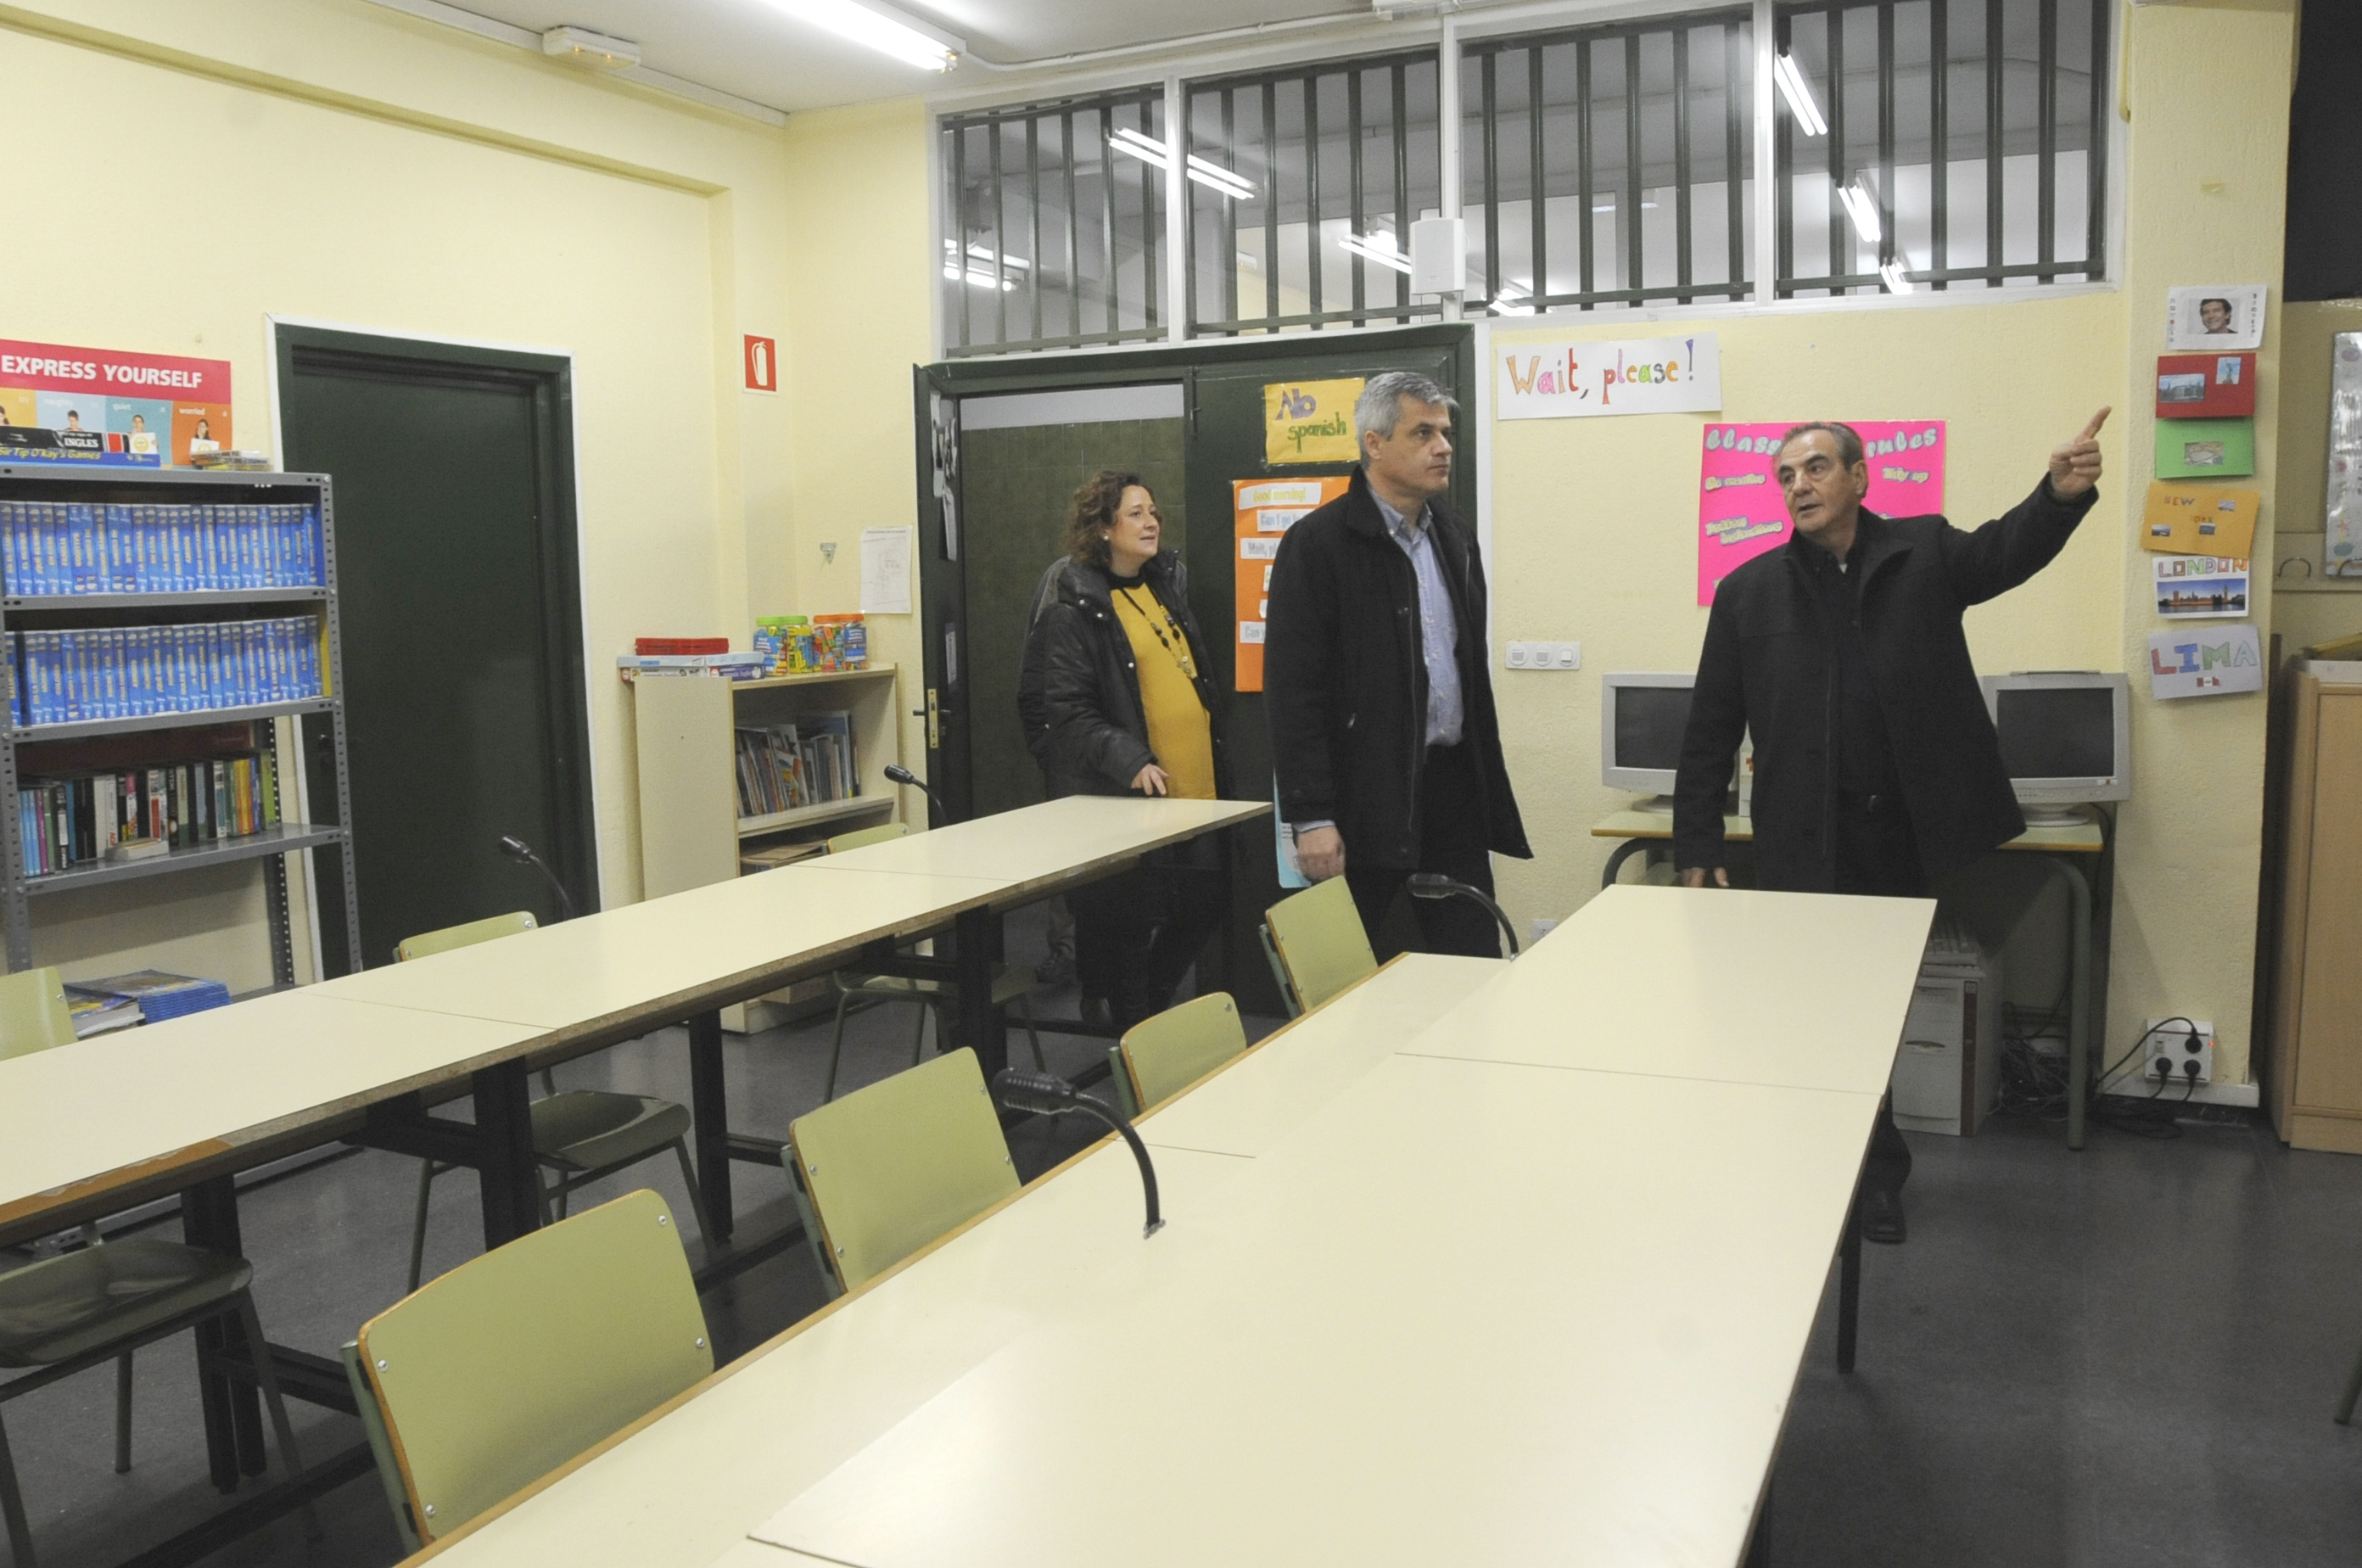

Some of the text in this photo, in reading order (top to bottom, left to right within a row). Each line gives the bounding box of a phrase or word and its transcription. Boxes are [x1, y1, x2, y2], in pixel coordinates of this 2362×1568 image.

[1, 355, 203, 389] EXPRESS YOURSELF
[1506, 347, 1589, 400] Wait,
[179, 407, 205, 416] worried
[1274, 388, 1317, 420] No
[1287, 412, 1347, 453] spanish
[1705, 428, 1939, 459] Class rules
[68, 450, 101, 459] Games
[2164, 496, 2196, 507] NEW
[2189, 515, 2214, 524] ORK
[2158, 557, 2248, 578] LONDON
[2151, 641, 2258, 675] LIMA
